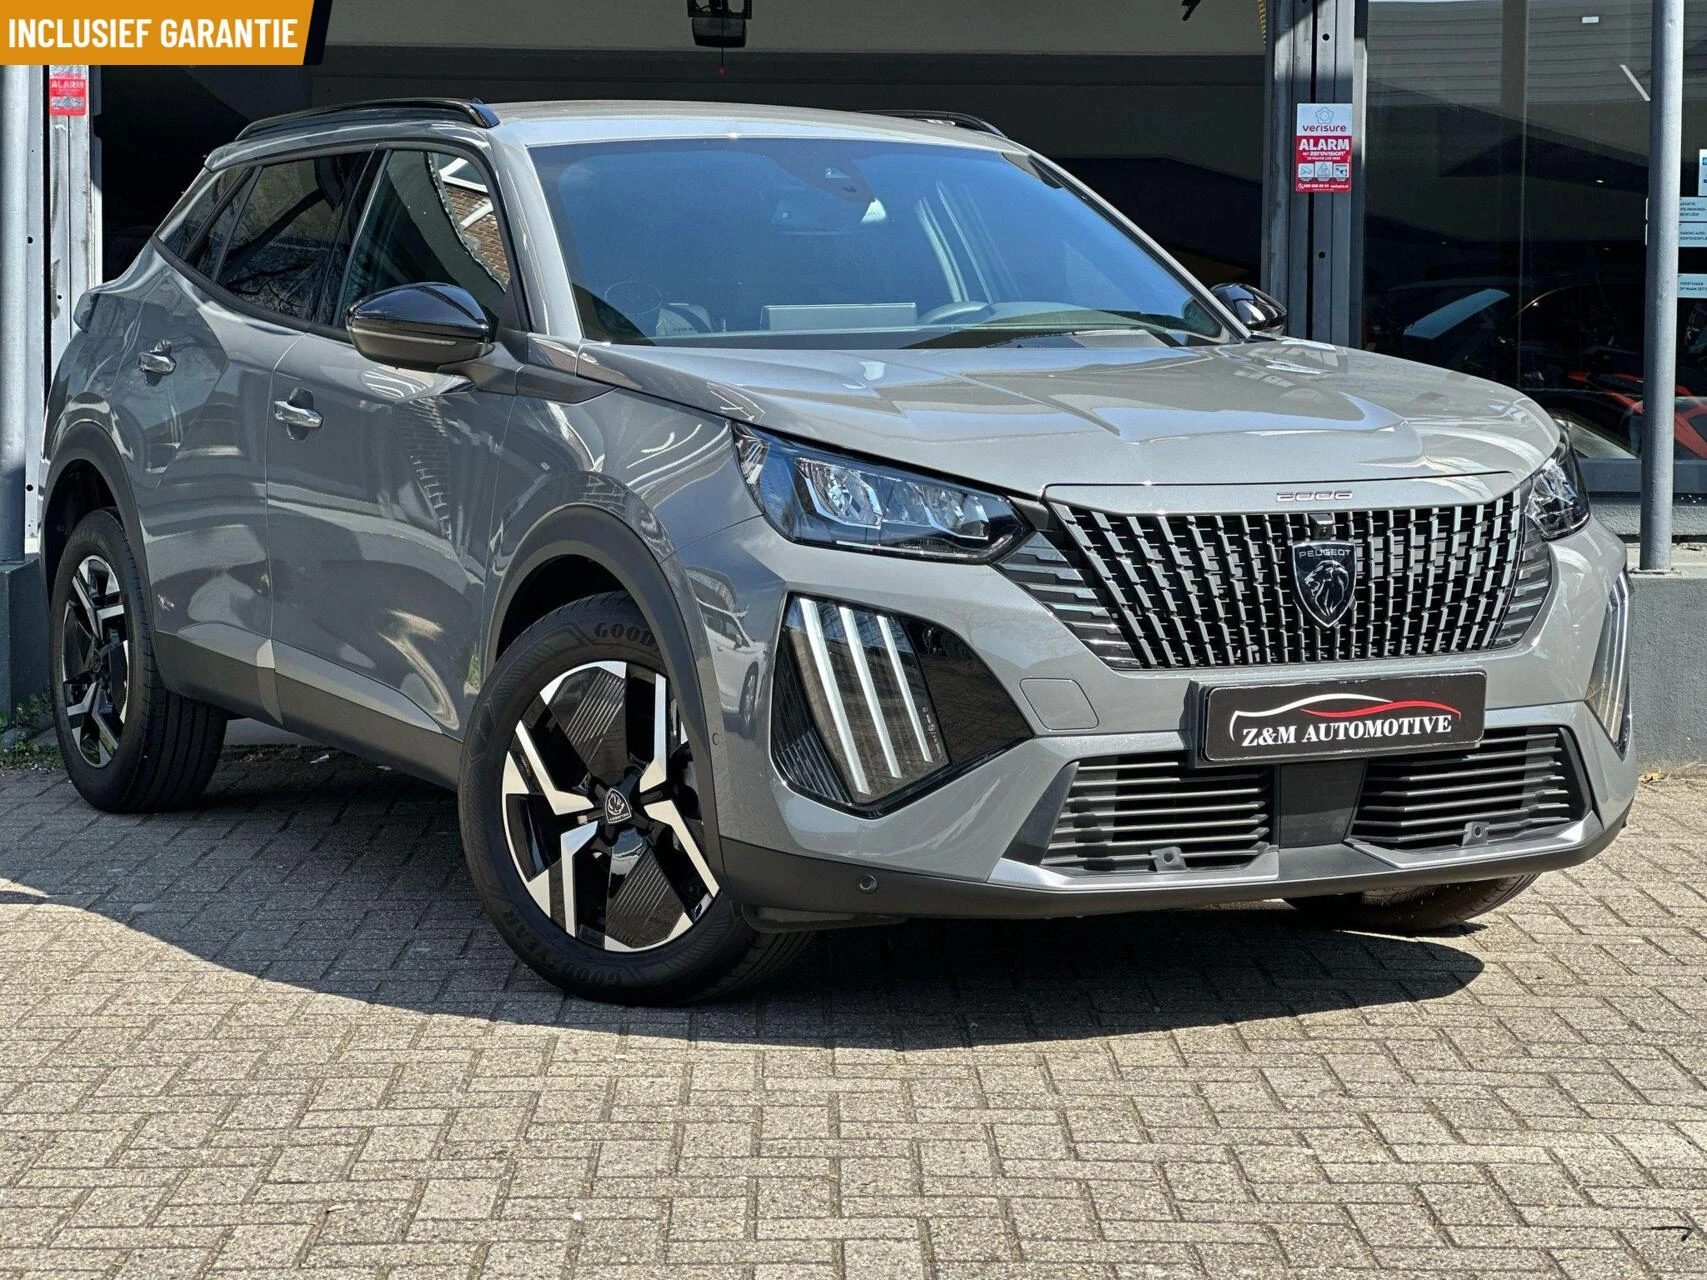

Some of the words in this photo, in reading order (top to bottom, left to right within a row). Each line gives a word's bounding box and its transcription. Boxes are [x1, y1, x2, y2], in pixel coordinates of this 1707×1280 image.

[1302, 124, 1347, 132] verisure
[1299, 138, 1349, 151] ALARM
[1299, 548, 1351, 558] PEUGEOT
[594, 622, 656, 647] GOOD
[1241, 725, 1297, 747] Z&M
[1301, 714, 1452, 743] AUTOMOTIVE
